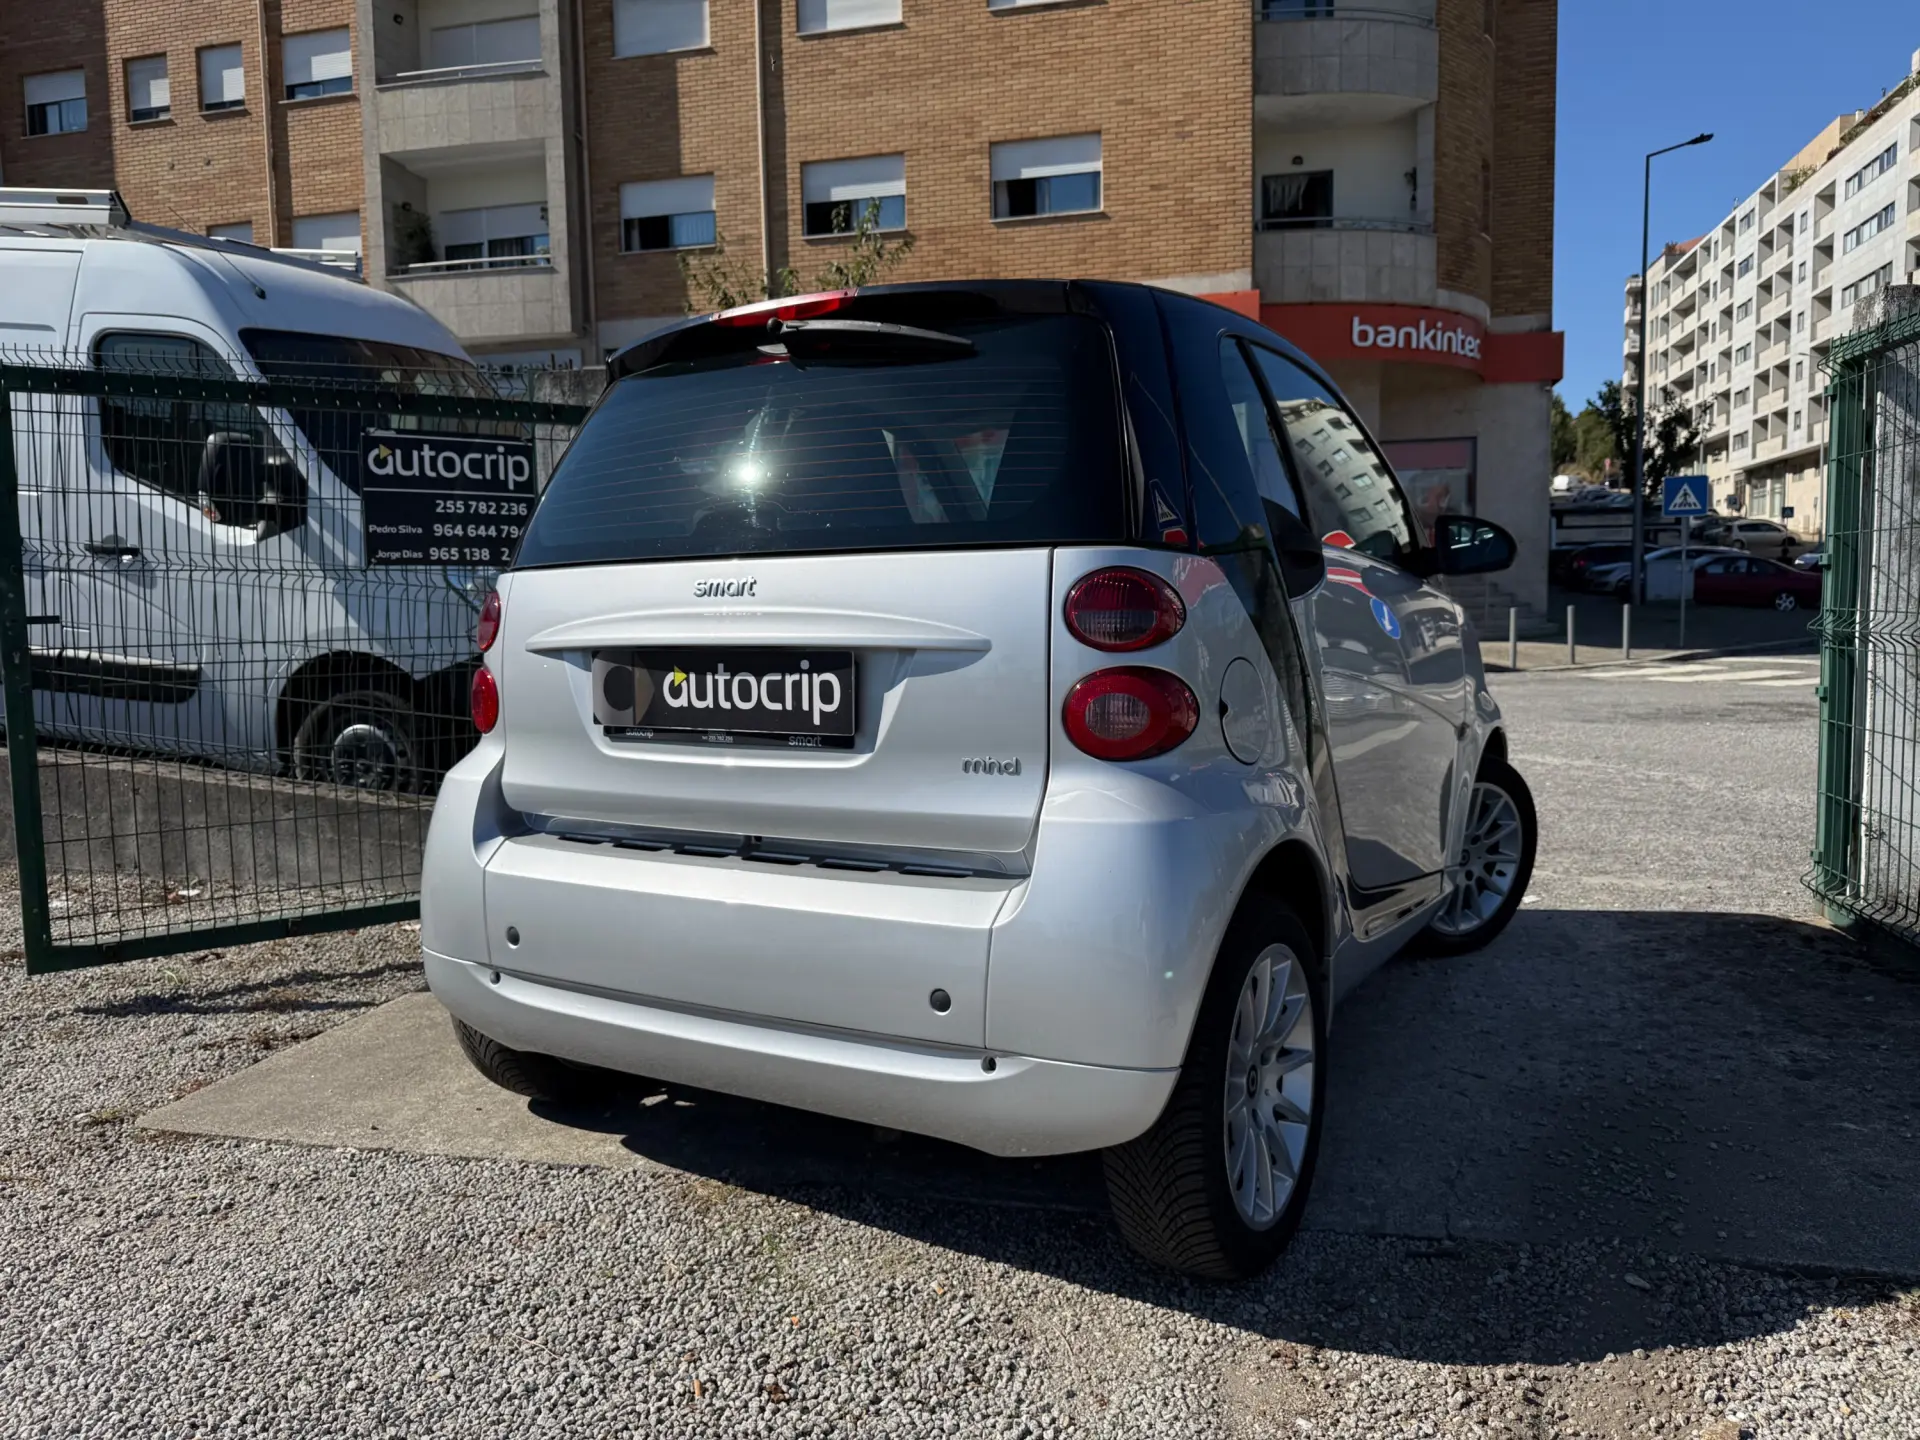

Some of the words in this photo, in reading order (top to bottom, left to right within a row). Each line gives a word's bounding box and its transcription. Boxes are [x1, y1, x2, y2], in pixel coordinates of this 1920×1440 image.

[1352, 316, 1481, 359] bankinter
[367, 443, 530, 490] autocrip
[435, 500, 465, 513] 255
[468, 501, 497, 515] 782
[500, 502, 528, 516] 236
[368, 524, 397, 534] Pedro
[398, 524, 423, 534] Silva
[433, 523, 464, 537] 964
[467, 525, 497, 538] 644
[375, 550, 401, 560] Jorge
[402, 549, 423, 559] Dias
[429, 547, 459, 561] 965
[463, 548, 490, 561] 138
[693, 575, 757, 598] smart
[663, 659, 841, 726] autocrip
[788, 735, 822, 747] smart
